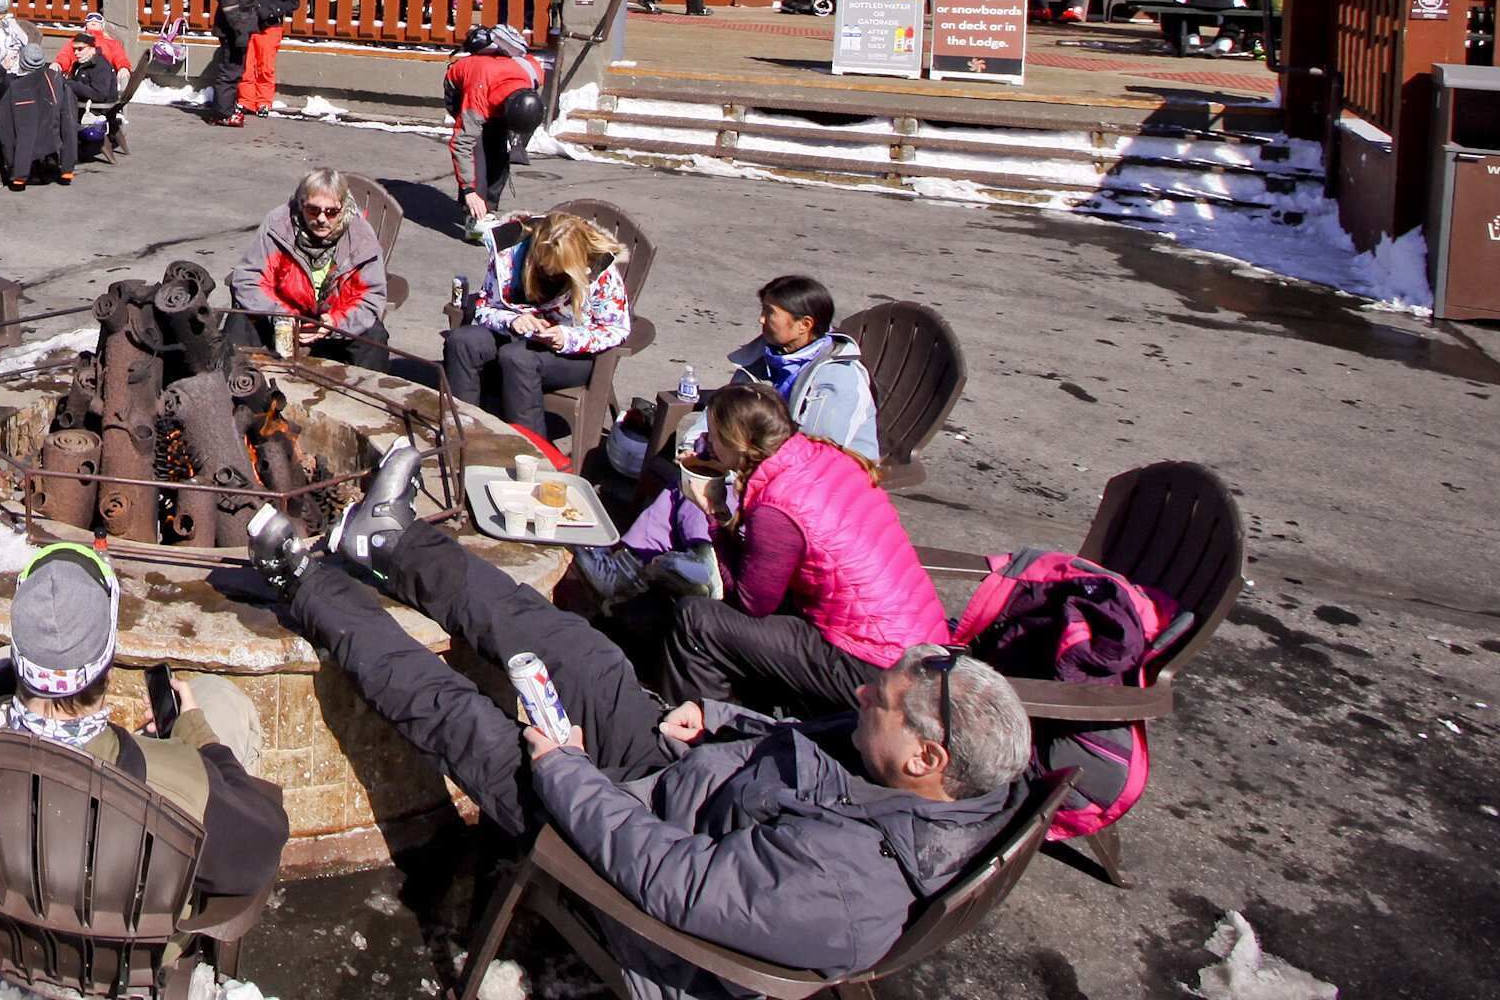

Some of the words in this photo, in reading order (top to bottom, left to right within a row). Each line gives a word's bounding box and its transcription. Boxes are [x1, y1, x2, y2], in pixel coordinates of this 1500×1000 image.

[952, 5, 1022, 16] snowboards
[941, 22, 956, 30] on
[958, 21, 987, 31] deck
[1005, 23, 1016, 32] in
[947, 36, 967, 46] the
[969, 37, 1009, 49] Lodge.
